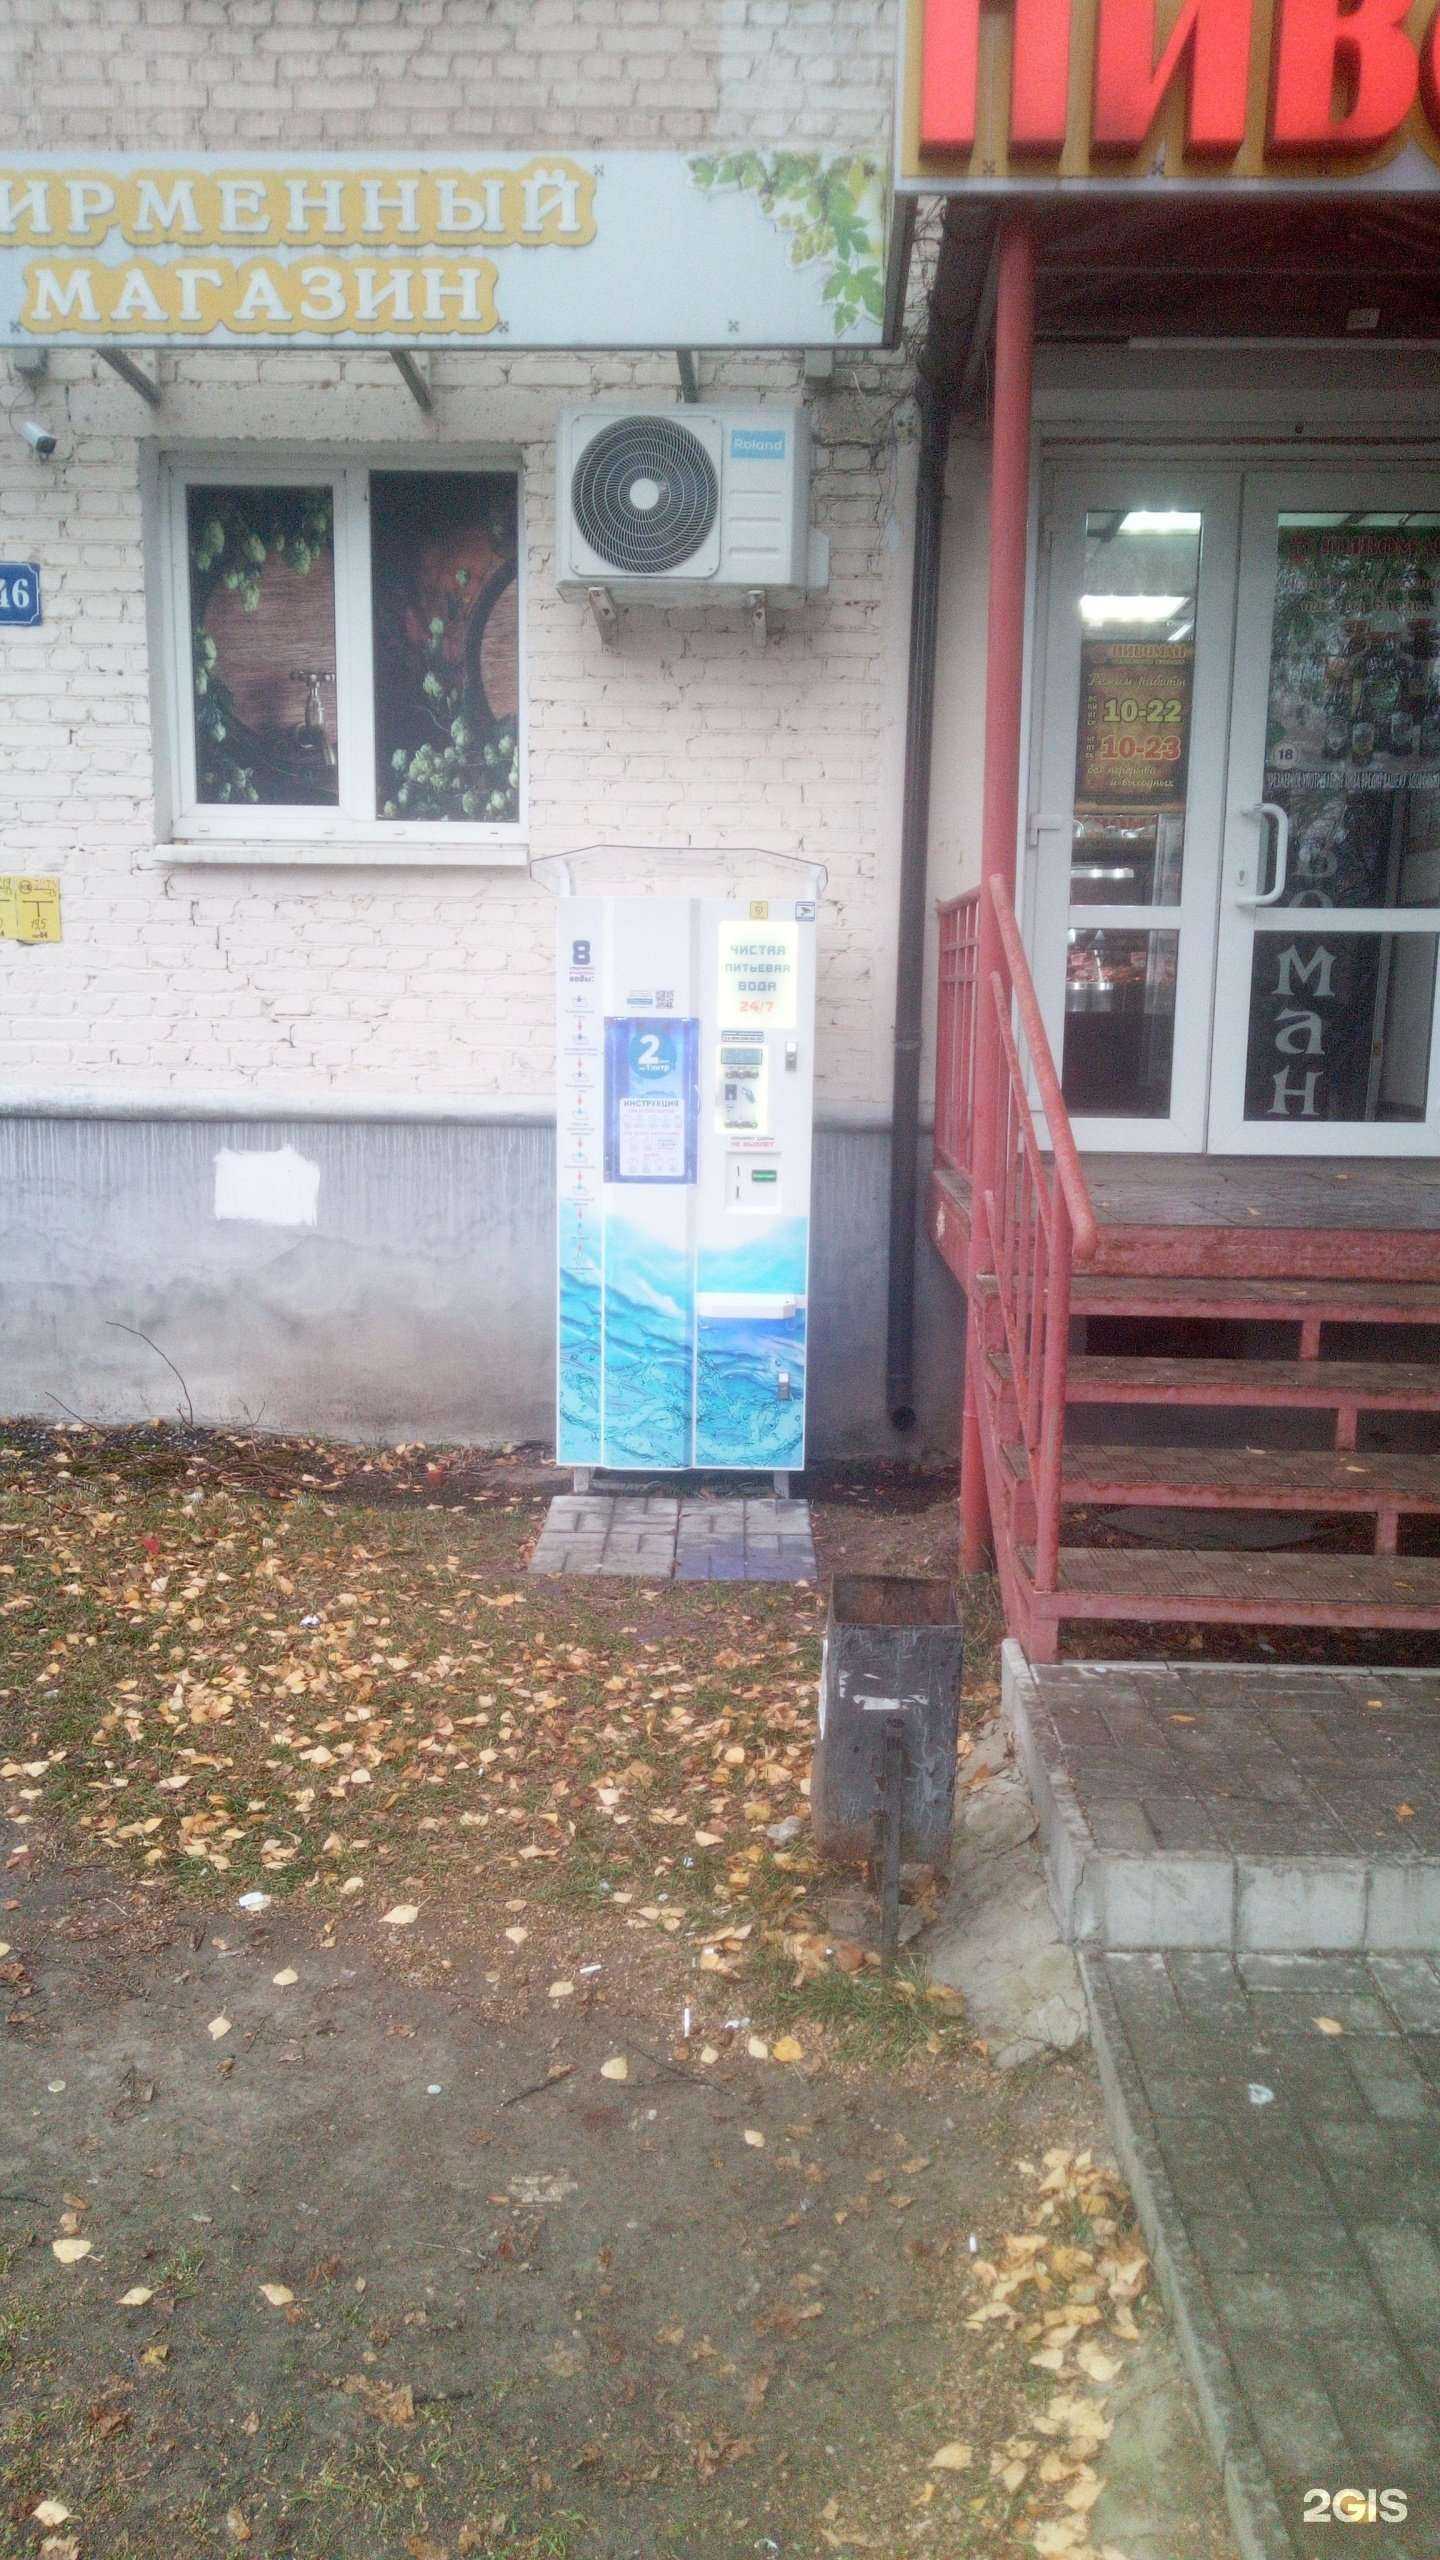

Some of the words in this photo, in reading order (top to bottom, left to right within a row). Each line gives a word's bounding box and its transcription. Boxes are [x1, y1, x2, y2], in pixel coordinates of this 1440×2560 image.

[918, 0, 1440, 166] ПИВ
[31, 267, 483, 321] МАГАЗИН
[734, 437, 784, 449] Roland
[1103, 698, 1183, 723] 10-22
[1101, 735, 1182, 761] 10-23
[572, 940, 591, 965] 8
[730, 944, 786, 956] ЧИСТАЯ
[737, 981, 777, 992] ВОДА
[739, 1001, 775, 1013] 24/7
[638, 1034, 661, 1065] 2
